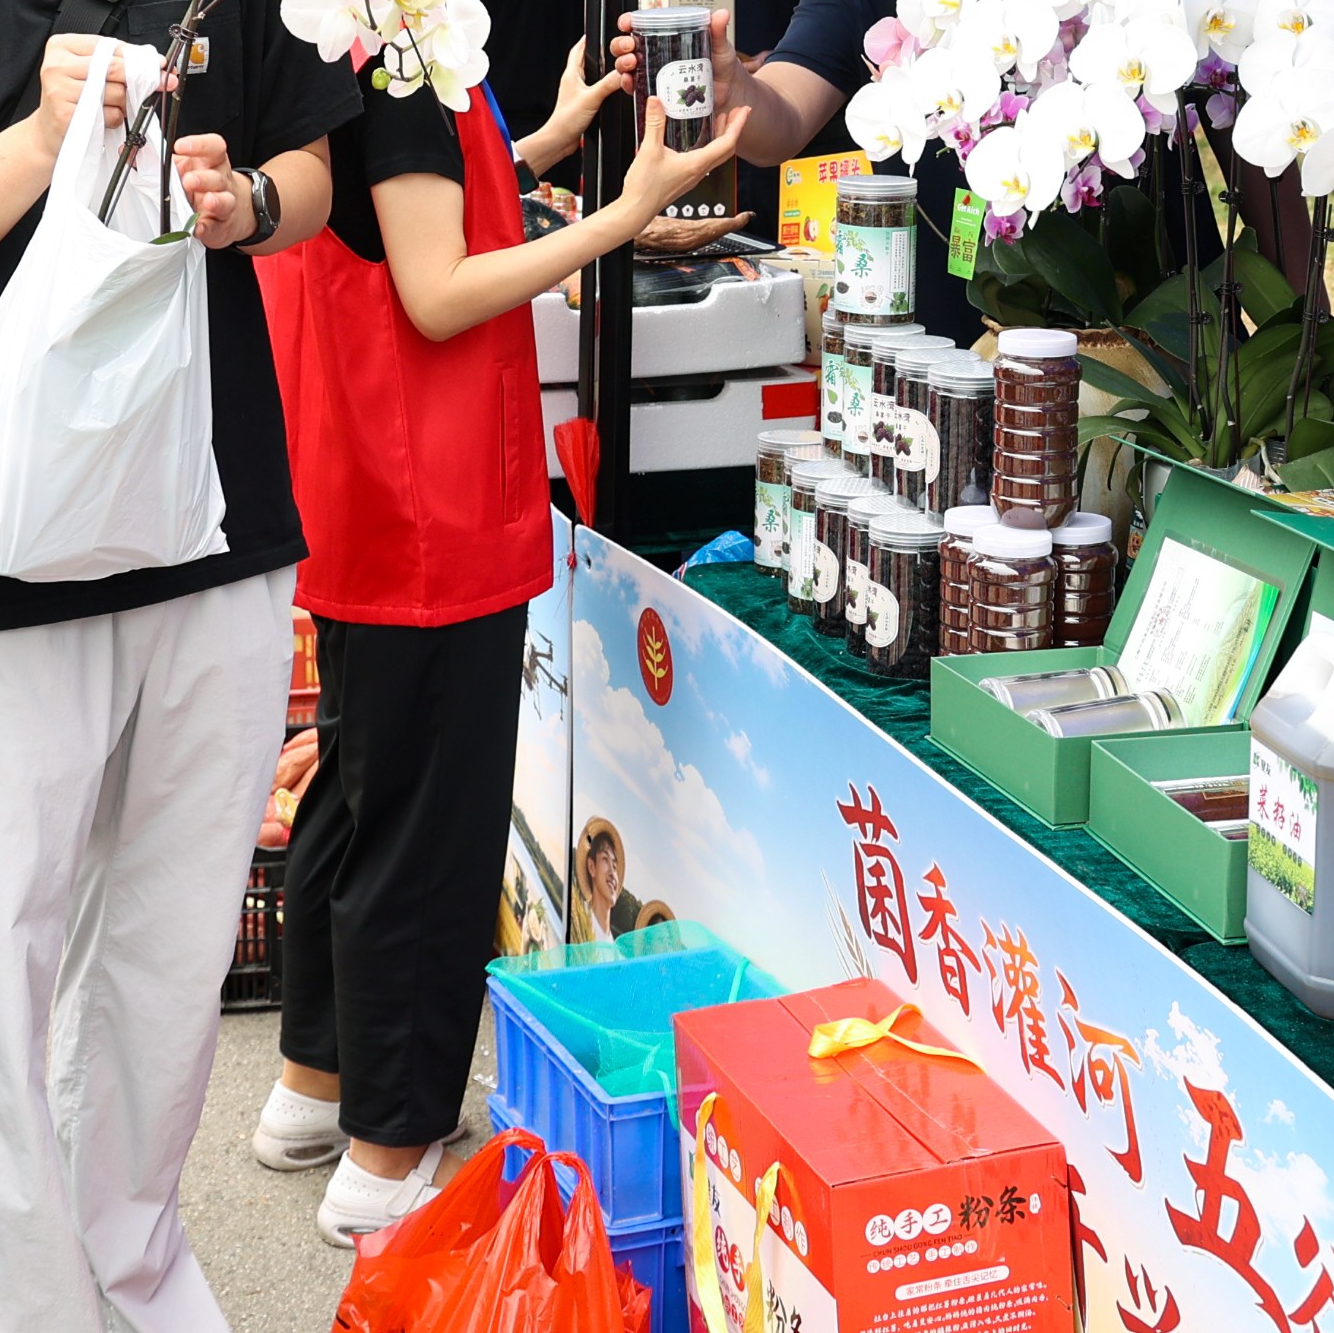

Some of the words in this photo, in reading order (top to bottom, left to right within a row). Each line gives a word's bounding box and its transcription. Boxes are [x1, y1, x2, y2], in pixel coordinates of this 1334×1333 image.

[818, 158, 861, 183] 苹果罐头
[850, 253, 873, 279] 桑
[847, 392, 865, 417] 桑
[762, 509, 780, 533] 桑
[1257, 782, 1302, 843] 菜籽油
[905, 1280, 942, 1297] 家常粉条
